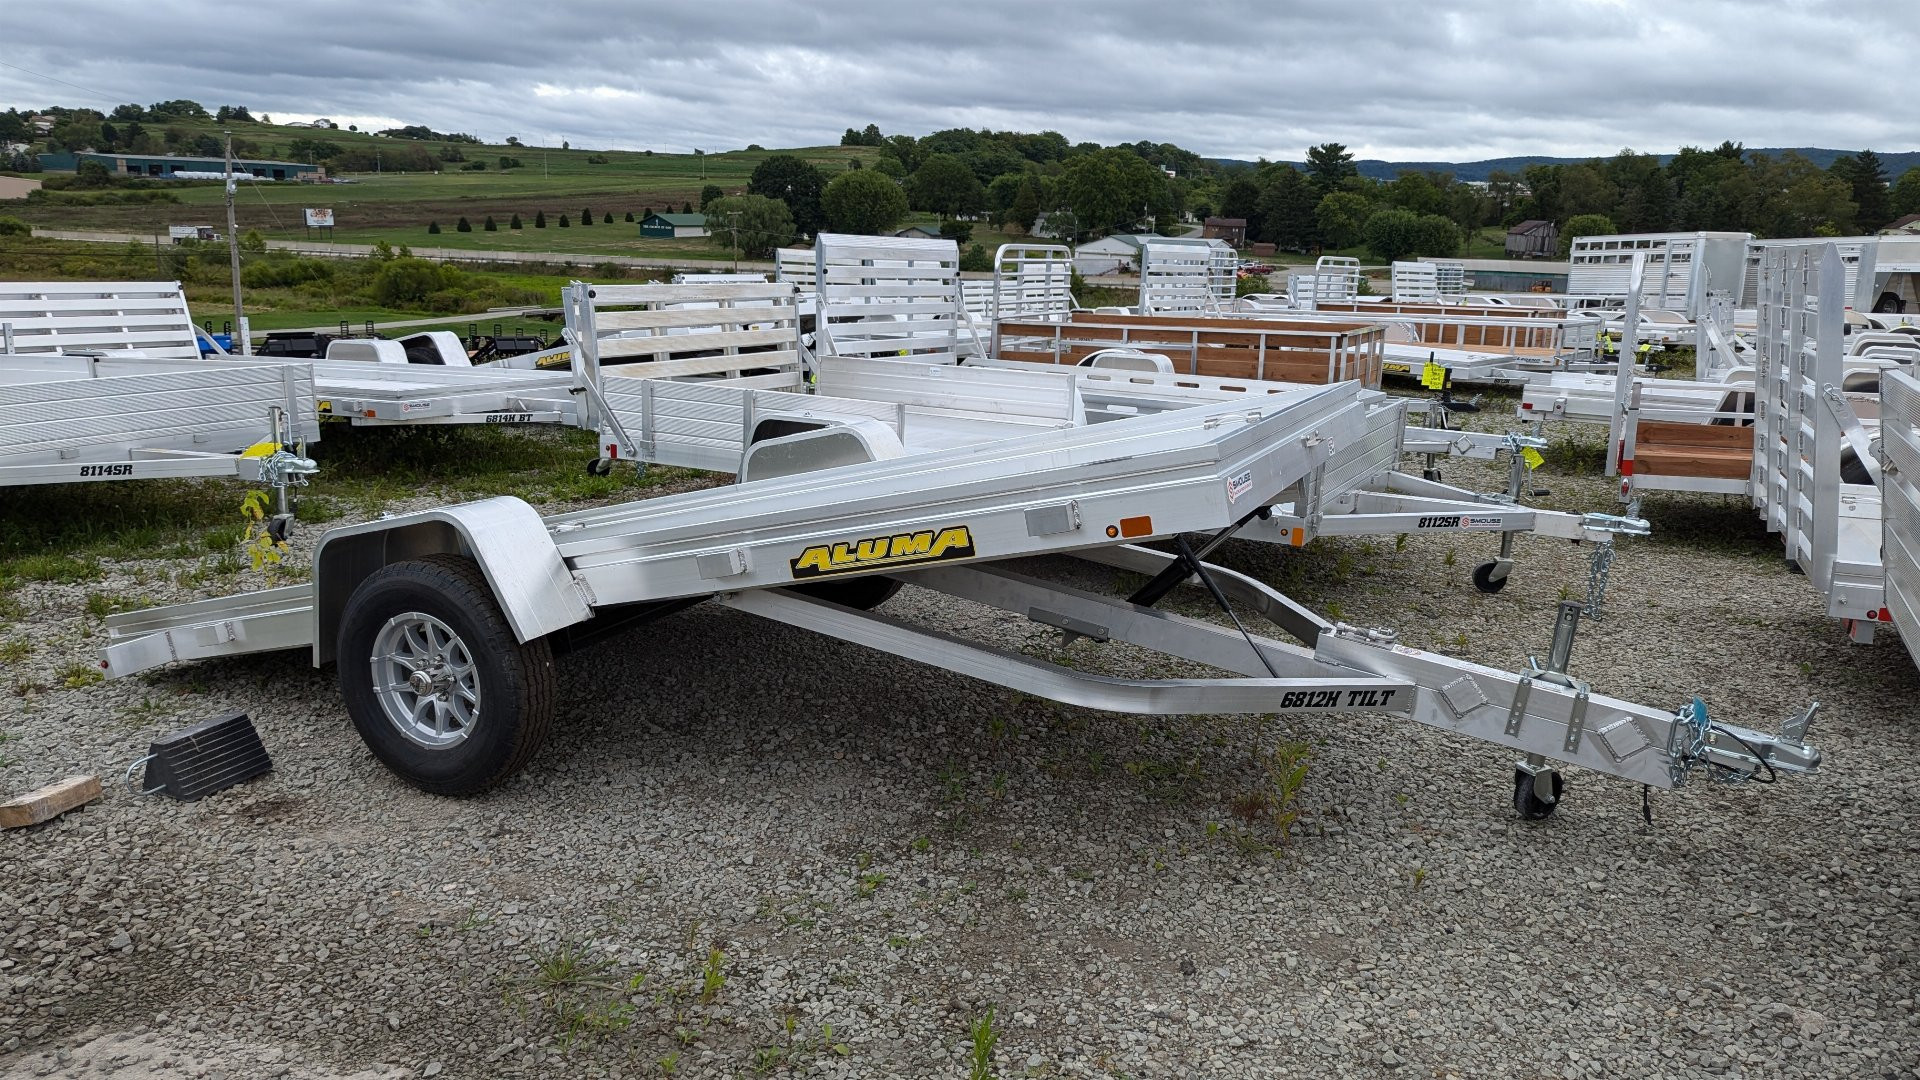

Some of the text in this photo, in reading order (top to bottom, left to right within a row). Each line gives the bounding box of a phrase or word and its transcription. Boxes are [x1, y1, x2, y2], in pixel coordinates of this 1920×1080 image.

[486, 414, 533, 423] 6814H BT
[80, 464, 133, 477] 8114SR
[1418, 516, 1460, 529] 8112SR
[794, 526, 971, 573] ALUMA
[1280, 689, 1397, 708] 6812H TILT
